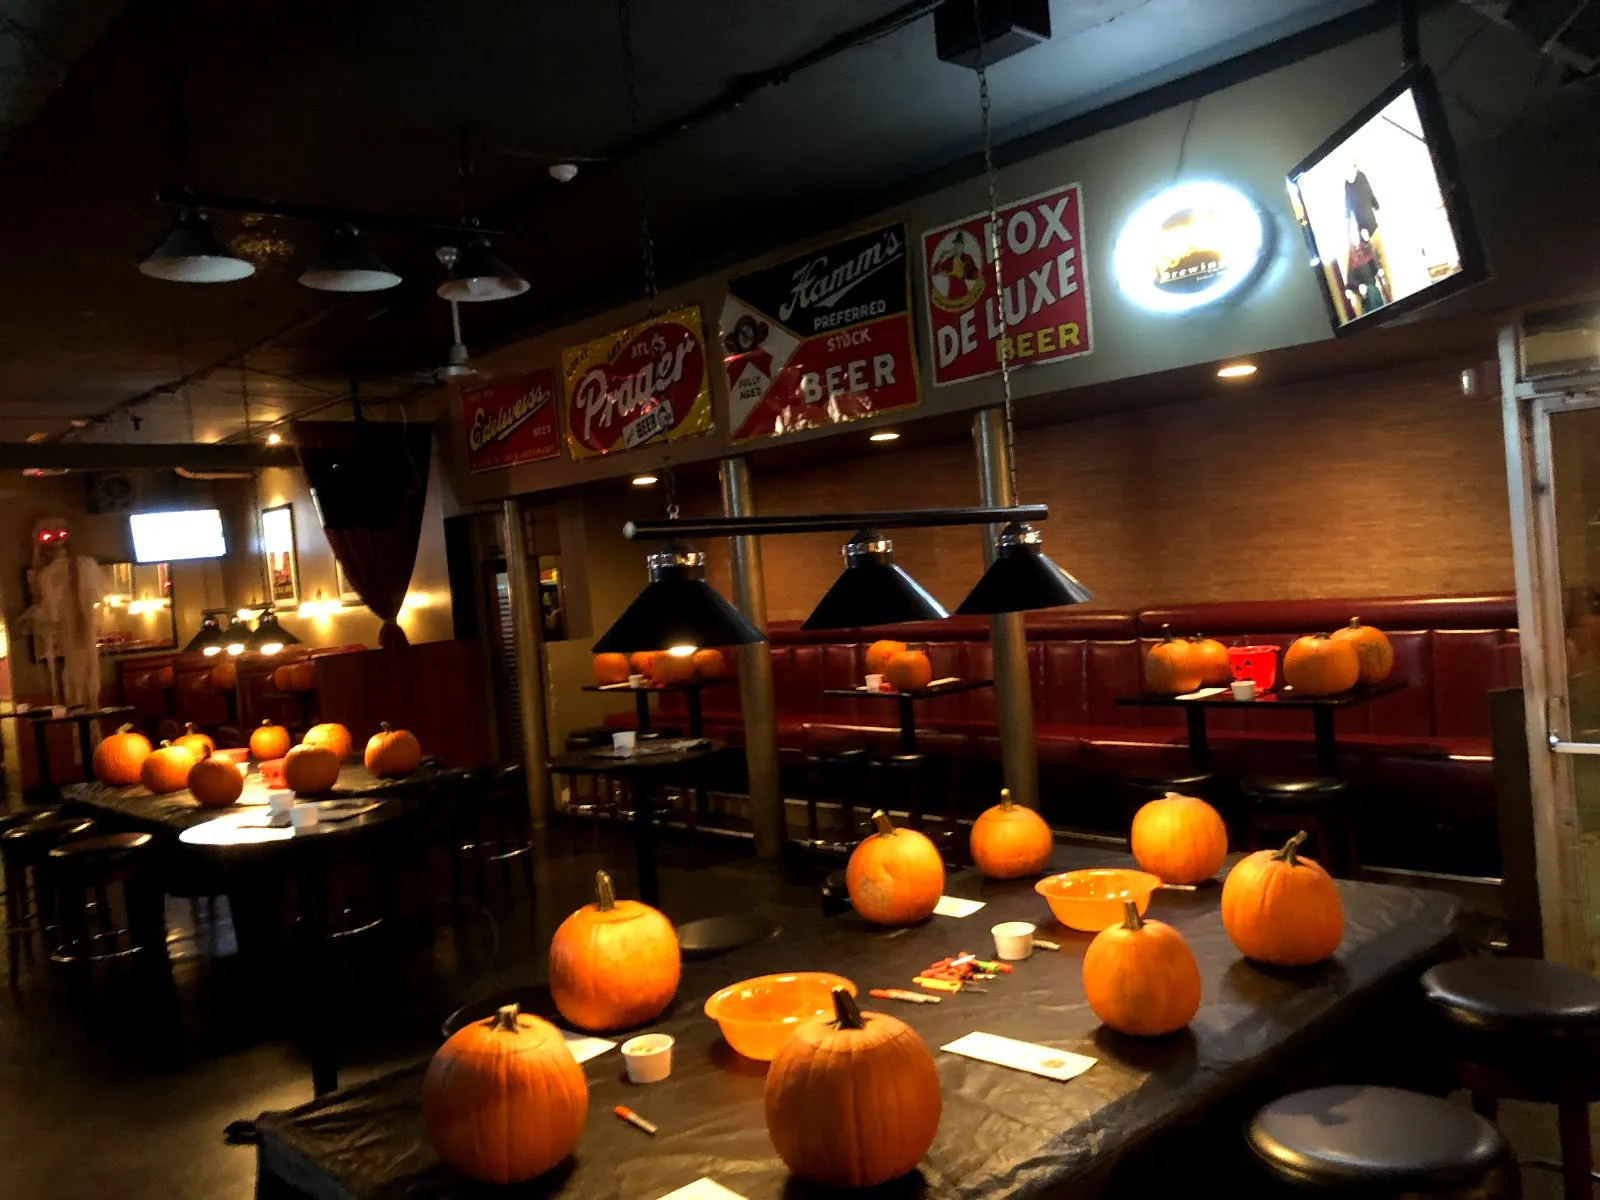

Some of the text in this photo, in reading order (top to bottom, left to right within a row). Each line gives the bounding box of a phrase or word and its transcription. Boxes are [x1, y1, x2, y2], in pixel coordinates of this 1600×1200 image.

[984, 197, 1073, 264] FOX
[779, 231, 903, 321] Hamm's
[938, 248, 1078, 368] DE LUXE
[814, 300, 886, 331] PREFERRED
[827, 328, 872, 352] STOCK
[996, 322, 1080, 362] BEER
[576, 338, 695, 441] Prager
[801, 353, 896, 404] BEER
[470, 384, 550, 451] Edelweiss
